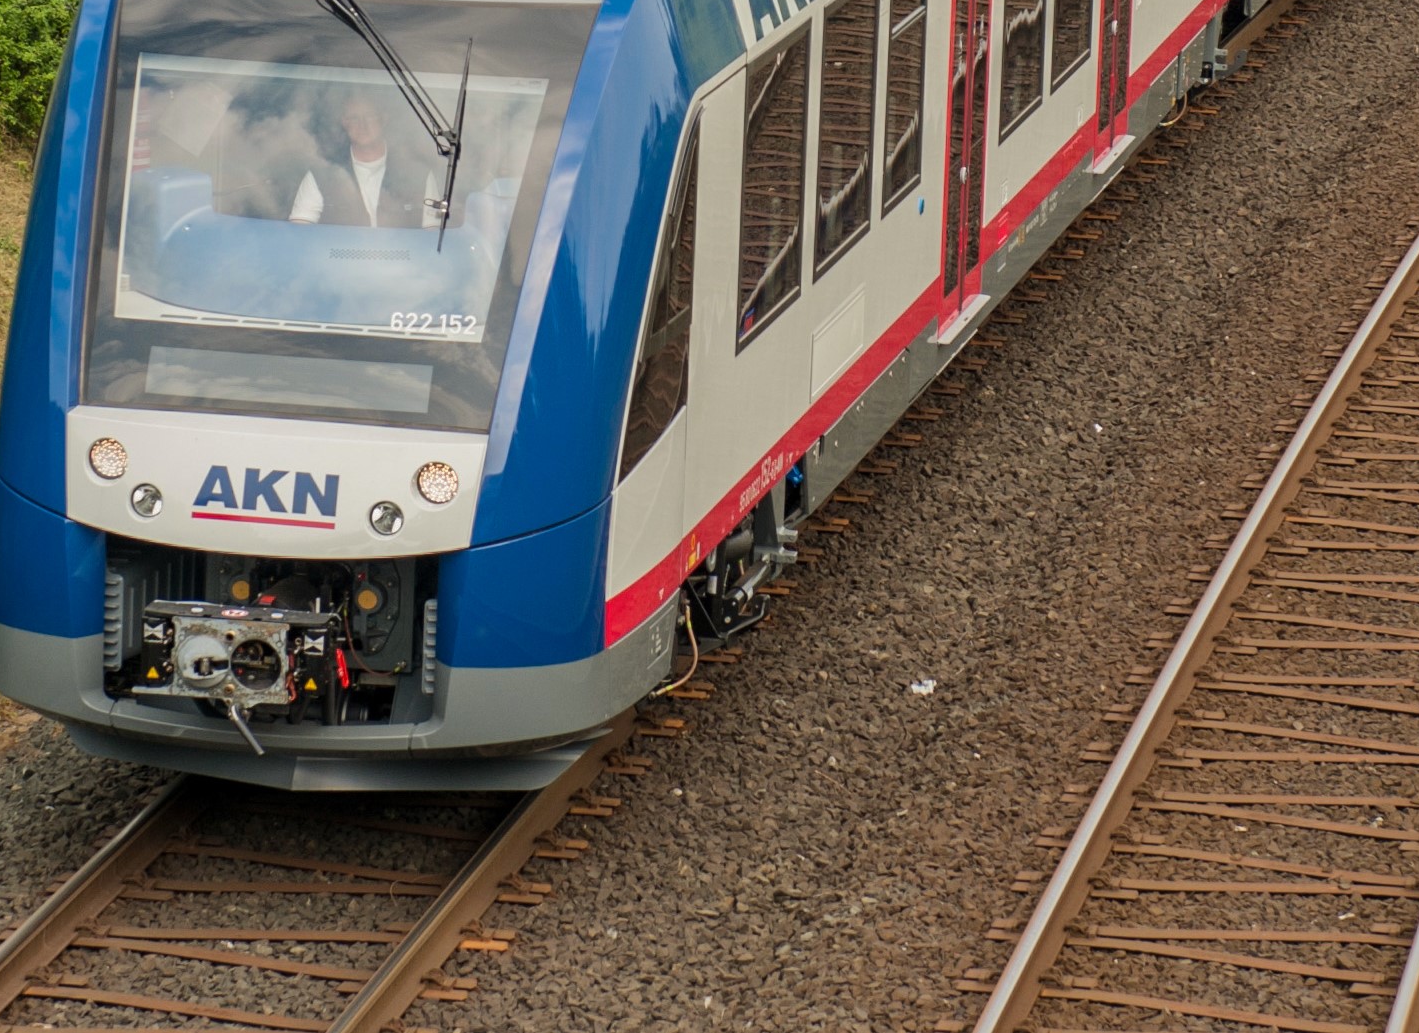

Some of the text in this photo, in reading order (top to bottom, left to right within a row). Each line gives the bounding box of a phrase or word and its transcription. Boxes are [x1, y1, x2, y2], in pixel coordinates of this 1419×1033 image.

[390, 312, 477, 335] 622 152
[193, 465, 340, 517] AKN
